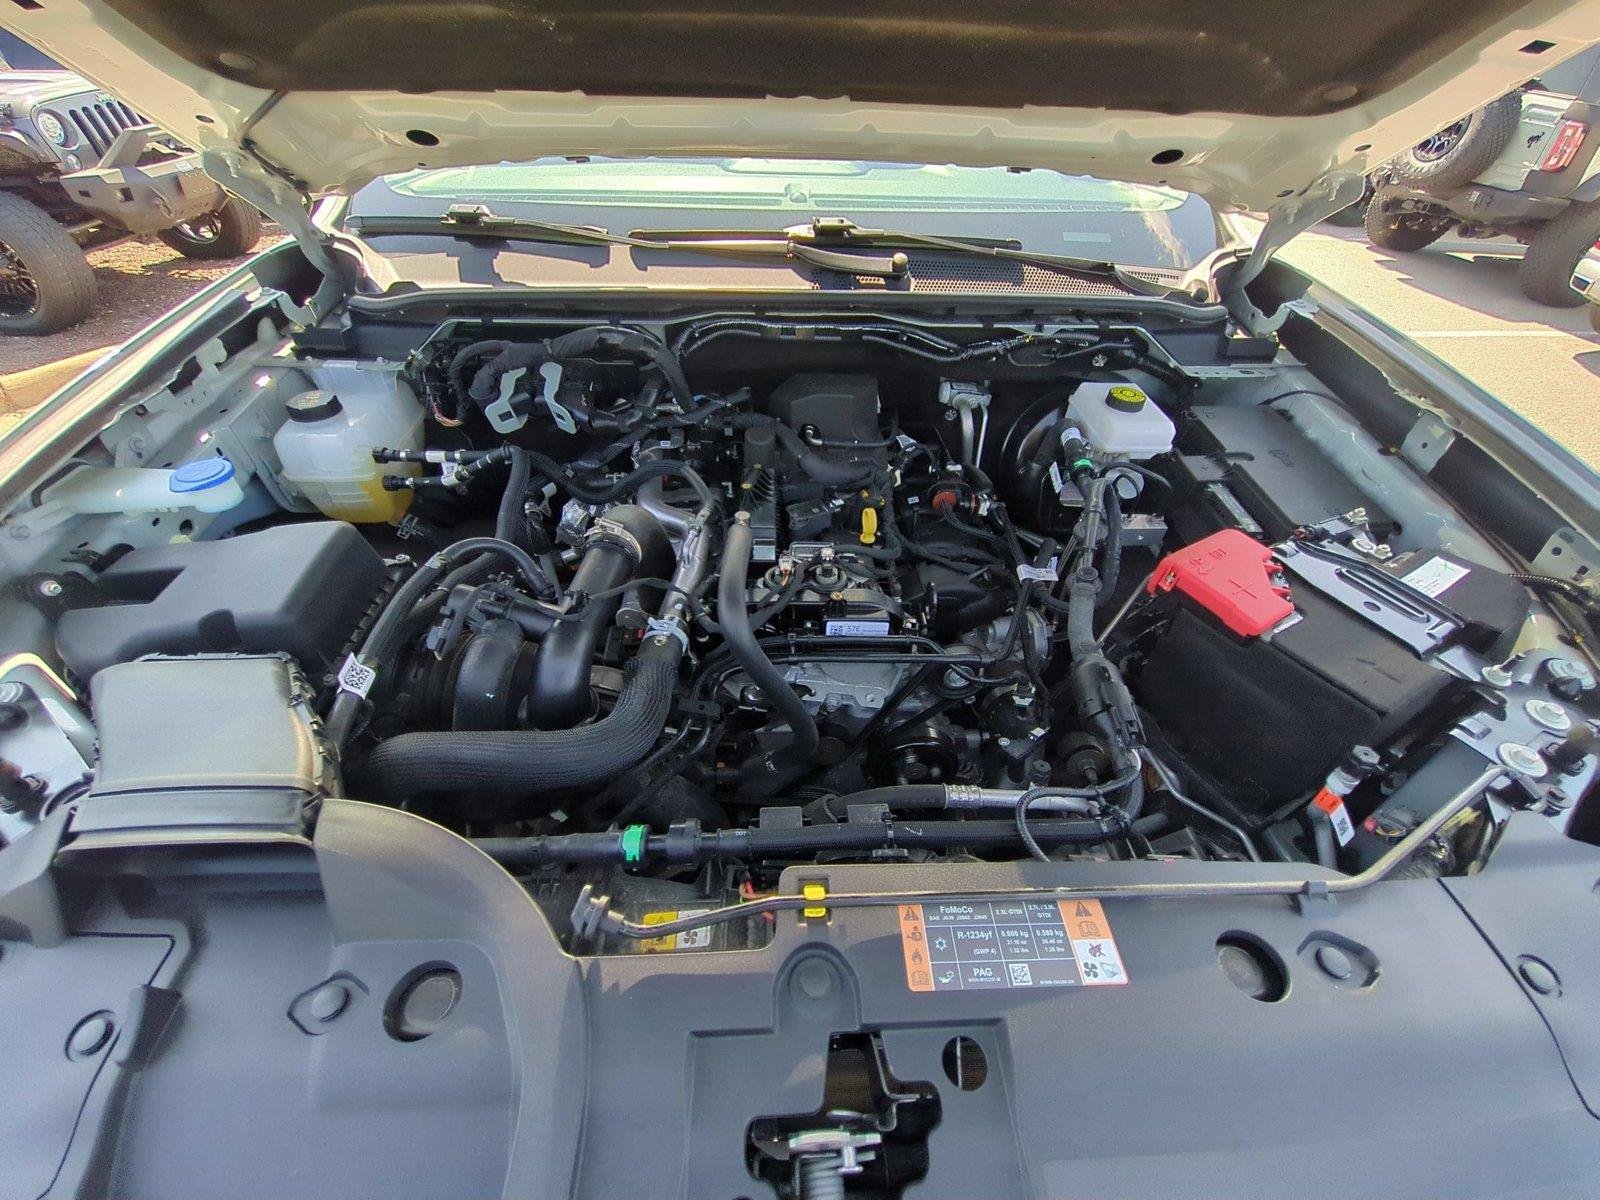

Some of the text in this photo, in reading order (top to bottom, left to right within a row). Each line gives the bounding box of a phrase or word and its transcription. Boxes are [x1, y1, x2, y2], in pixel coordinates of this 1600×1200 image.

[939, 905, 974, 914] FoMoCo
[957, 930, 993, 941] R-1234yf
[1019, 930, 1029, 938] kg
[1054, 929, 1064, 938] kg
[973, 967, 993, 977] PAG
